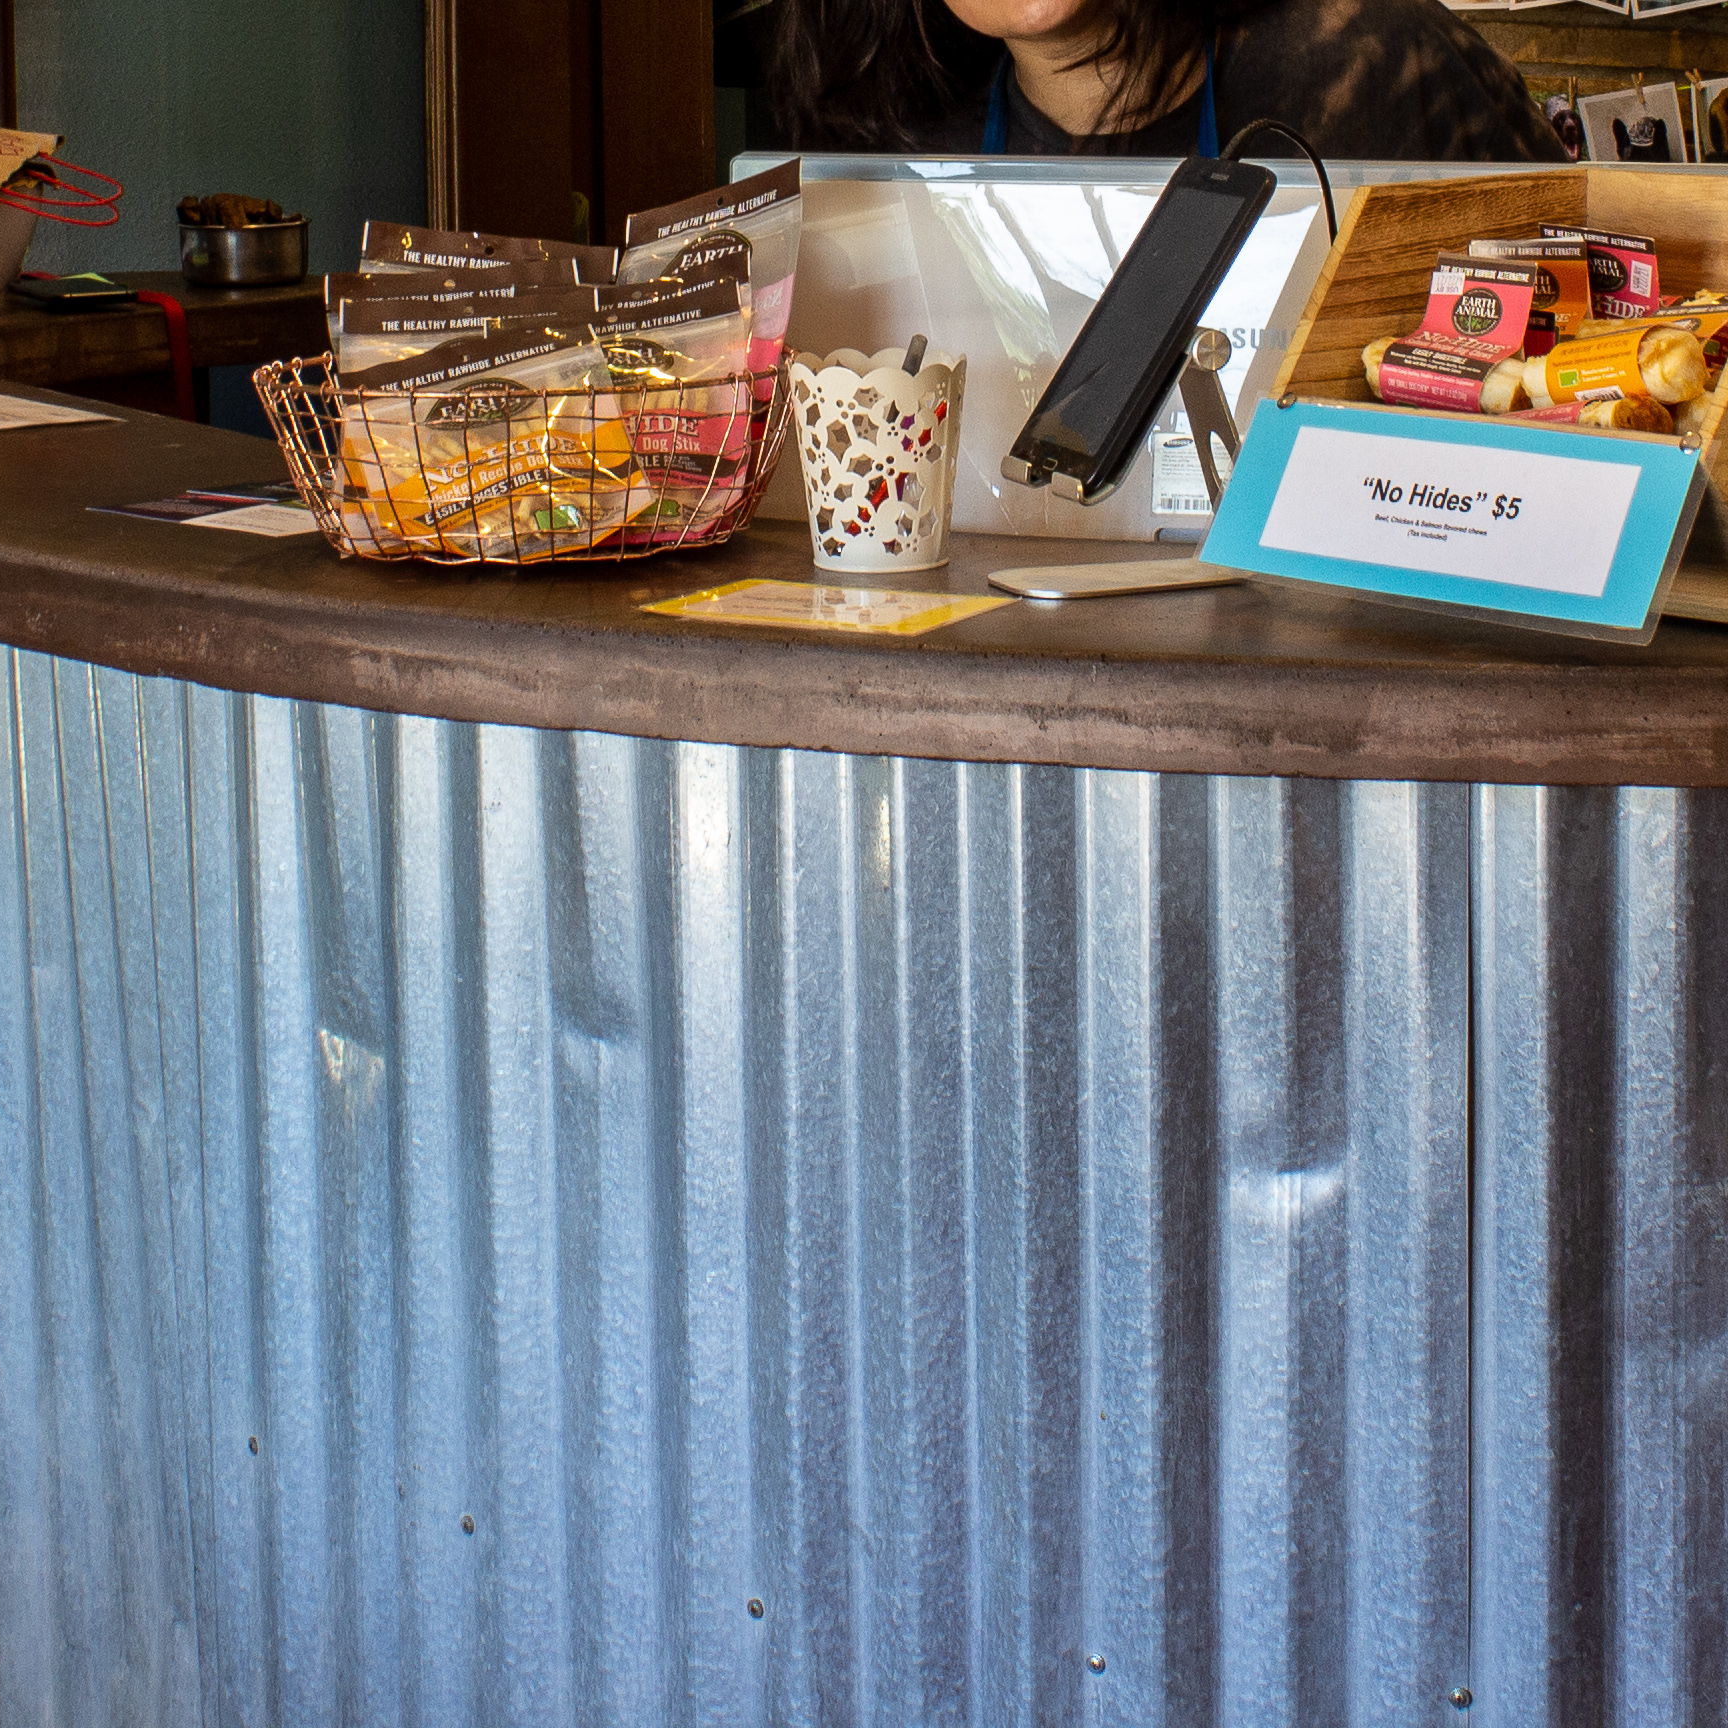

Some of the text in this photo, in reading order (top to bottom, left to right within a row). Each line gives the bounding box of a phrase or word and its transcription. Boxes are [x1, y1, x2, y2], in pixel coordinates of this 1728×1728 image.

[657, 189, 777, 238] THE HEALTHY RAWHIDE ALTERNATIVE
[1517, 247, 1580, 256] RAWHIDE ALTERNATIVE
[1610, 238, 1647, 250] ALTERNATIVE
[403, 251, 467, 268] THE HEALTHY
[1462, 296, 1496, 308] EARTH
[641, 309, 701, 328] ALTERNATIVE
[1456, 305, 1499, 319] ANIMAL
[382, 320, 446, 331] THE HEALTHY
[402, 344, 556, 388] HEALTHY RAWHIDE ALTERNATIVE
[643, 437, 700, 452] Dog Stix
[1491, 493, 1522, 520] $5
